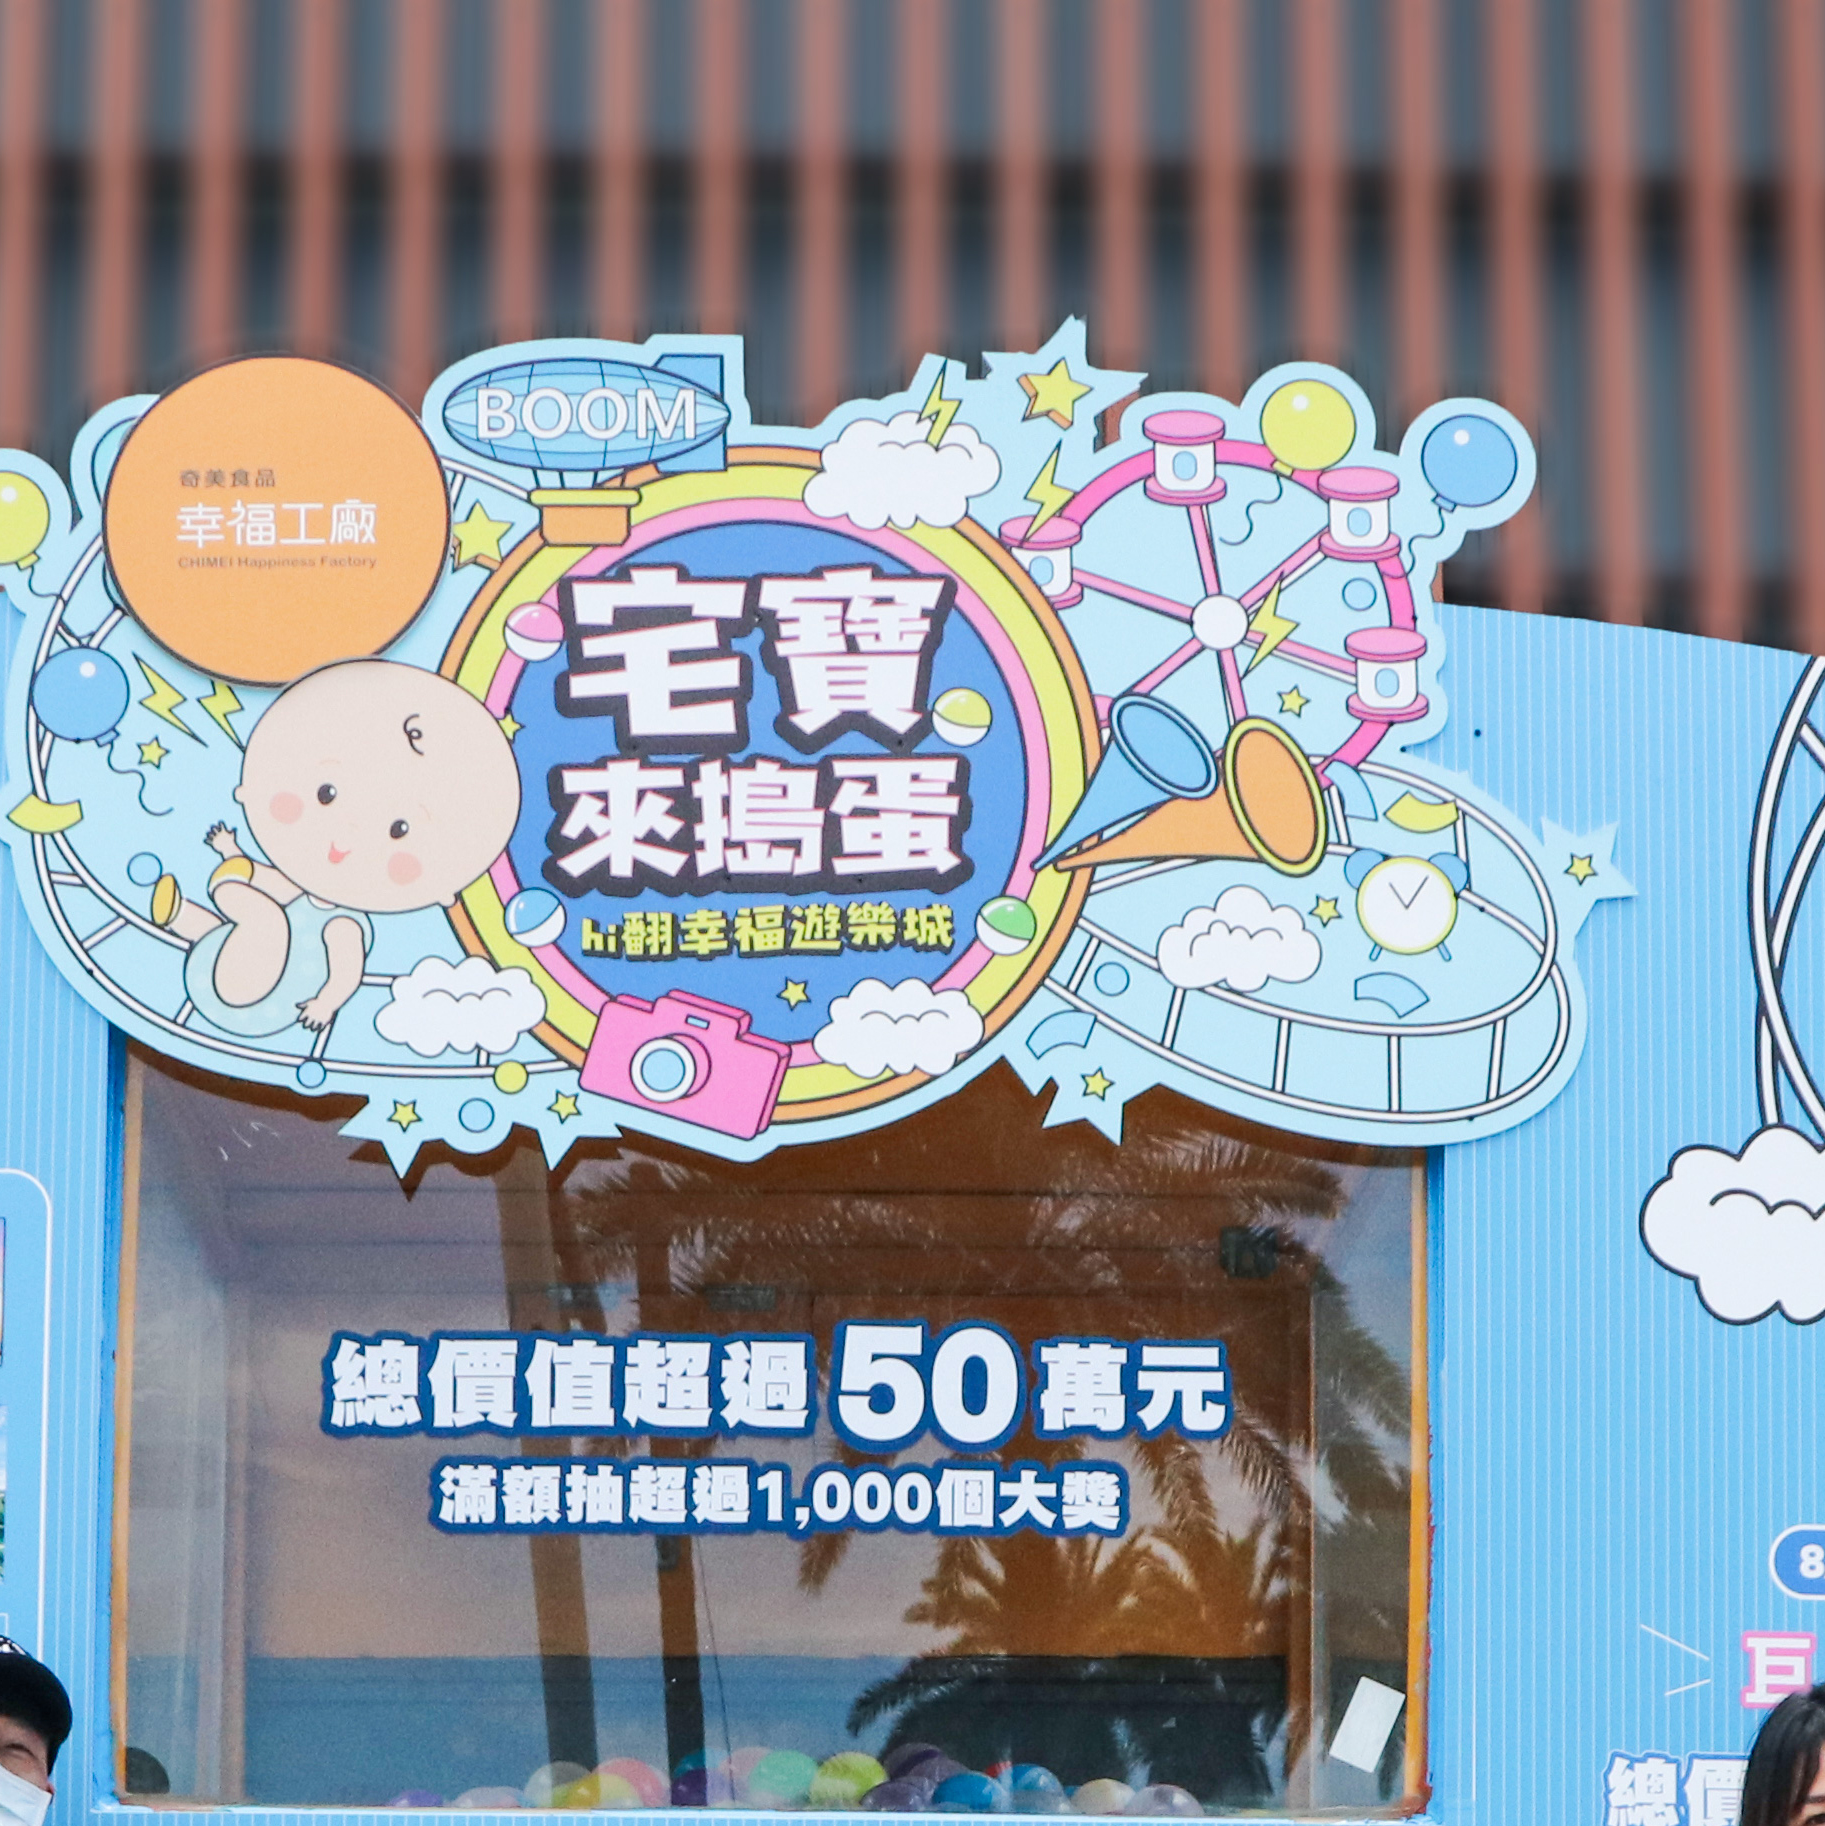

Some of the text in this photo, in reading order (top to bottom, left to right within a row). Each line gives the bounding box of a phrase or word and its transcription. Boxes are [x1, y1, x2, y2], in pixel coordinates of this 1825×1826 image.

[476, 386, 698, 441] BOOM
[179, 468, 276, 489] 奇美食品
[176, 498, 378, 549] 幸福工廠
[178, 554, 378, 569] CHIMEI Happiness Factory
[568, 566, 948, 736] 宅寶
[556, 757, 963, 879] 來搗蛋
[581, 902, 955, 956] hi翻幸福遊樂城
[330, 1325, 1226, 1443] 總價值超過 50 萬元
[438, 1464, 1122, 1531] 滿額抽超過1,000個大獎
